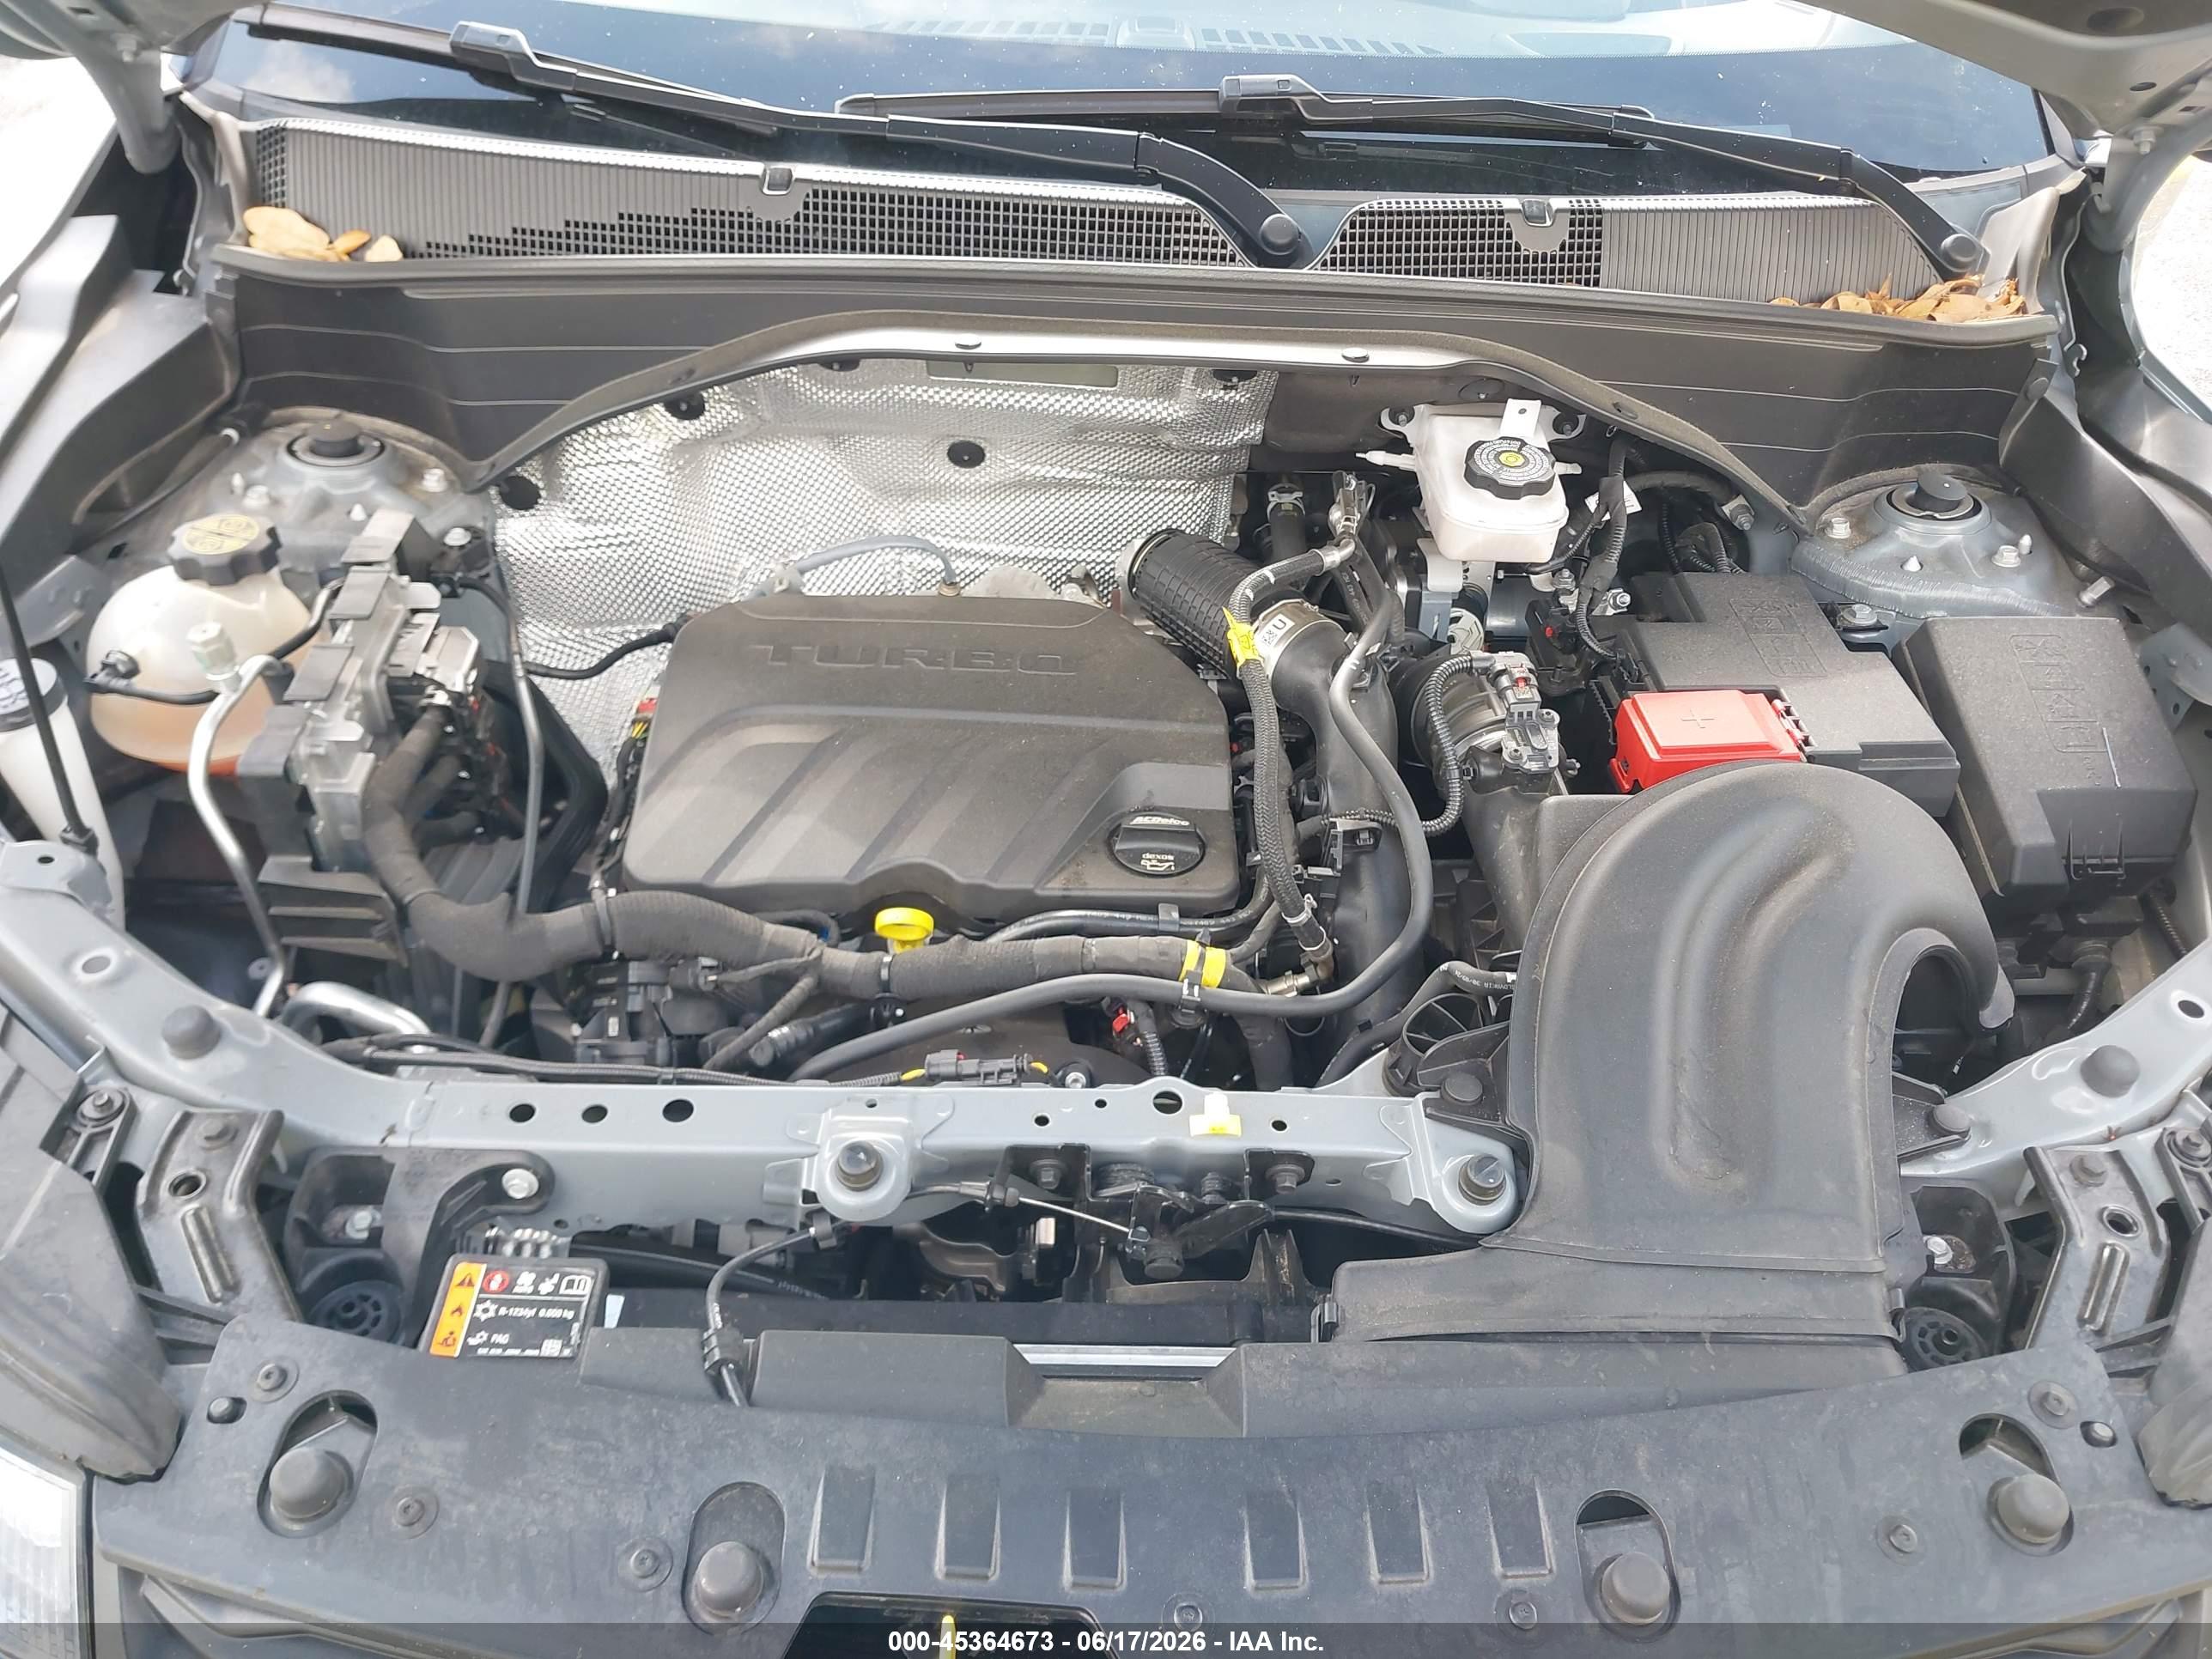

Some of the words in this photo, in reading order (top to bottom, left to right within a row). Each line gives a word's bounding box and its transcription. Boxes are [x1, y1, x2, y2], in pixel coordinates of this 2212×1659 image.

[749, 643, 1078, 676] TURBO
[1130, 816, 1190, 826] ACDelco
[490, 1334, 510, 1345] PAG
